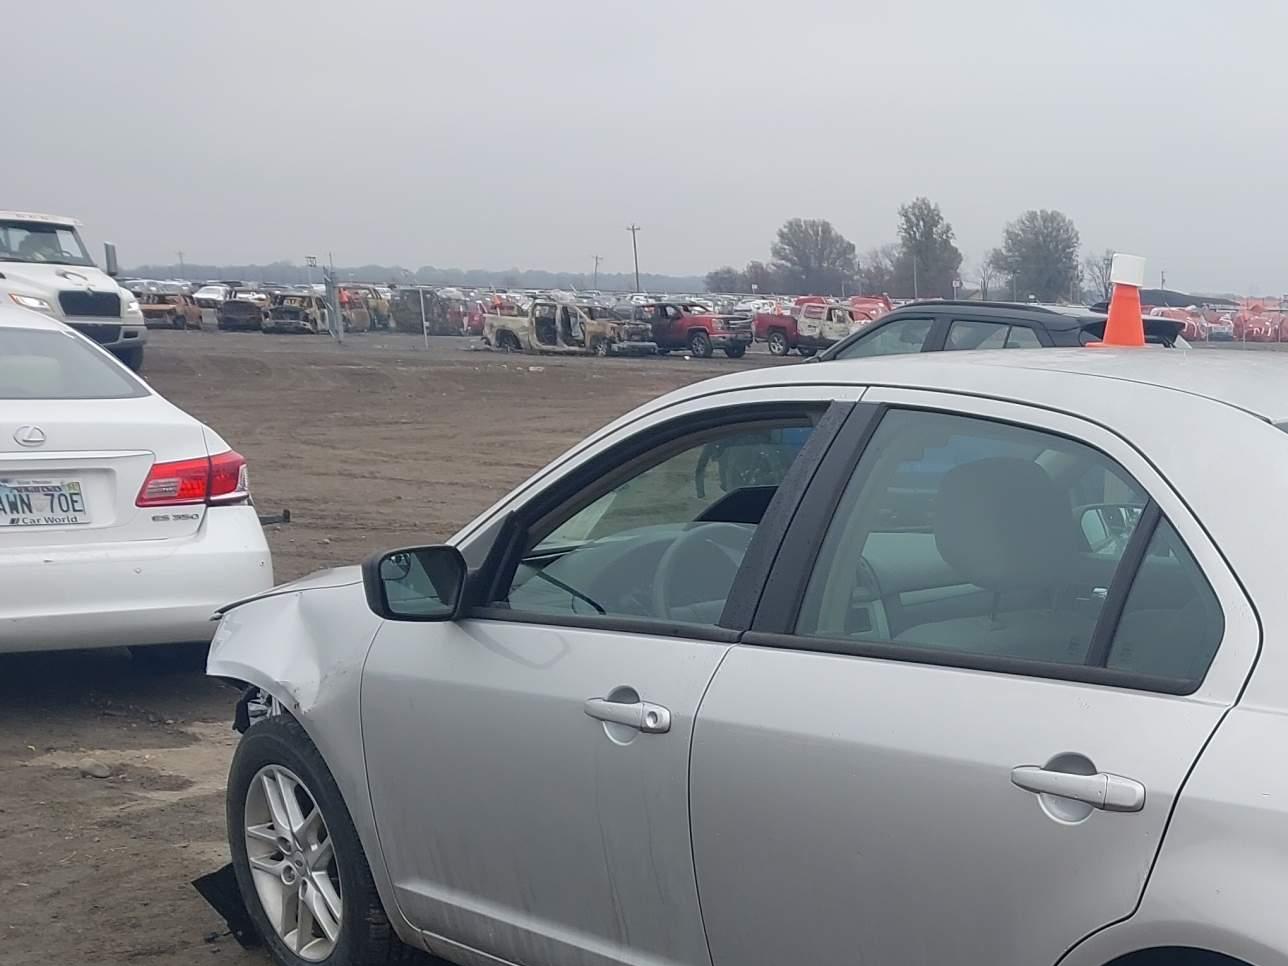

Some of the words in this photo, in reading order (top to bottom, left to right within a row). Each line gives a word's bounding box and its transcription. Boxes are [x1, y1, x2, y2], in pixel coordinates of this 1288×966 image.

[22, 517, 42, 525] Car
[43, 515, 78, 524] World
[172, 513, 200, 521] 350
